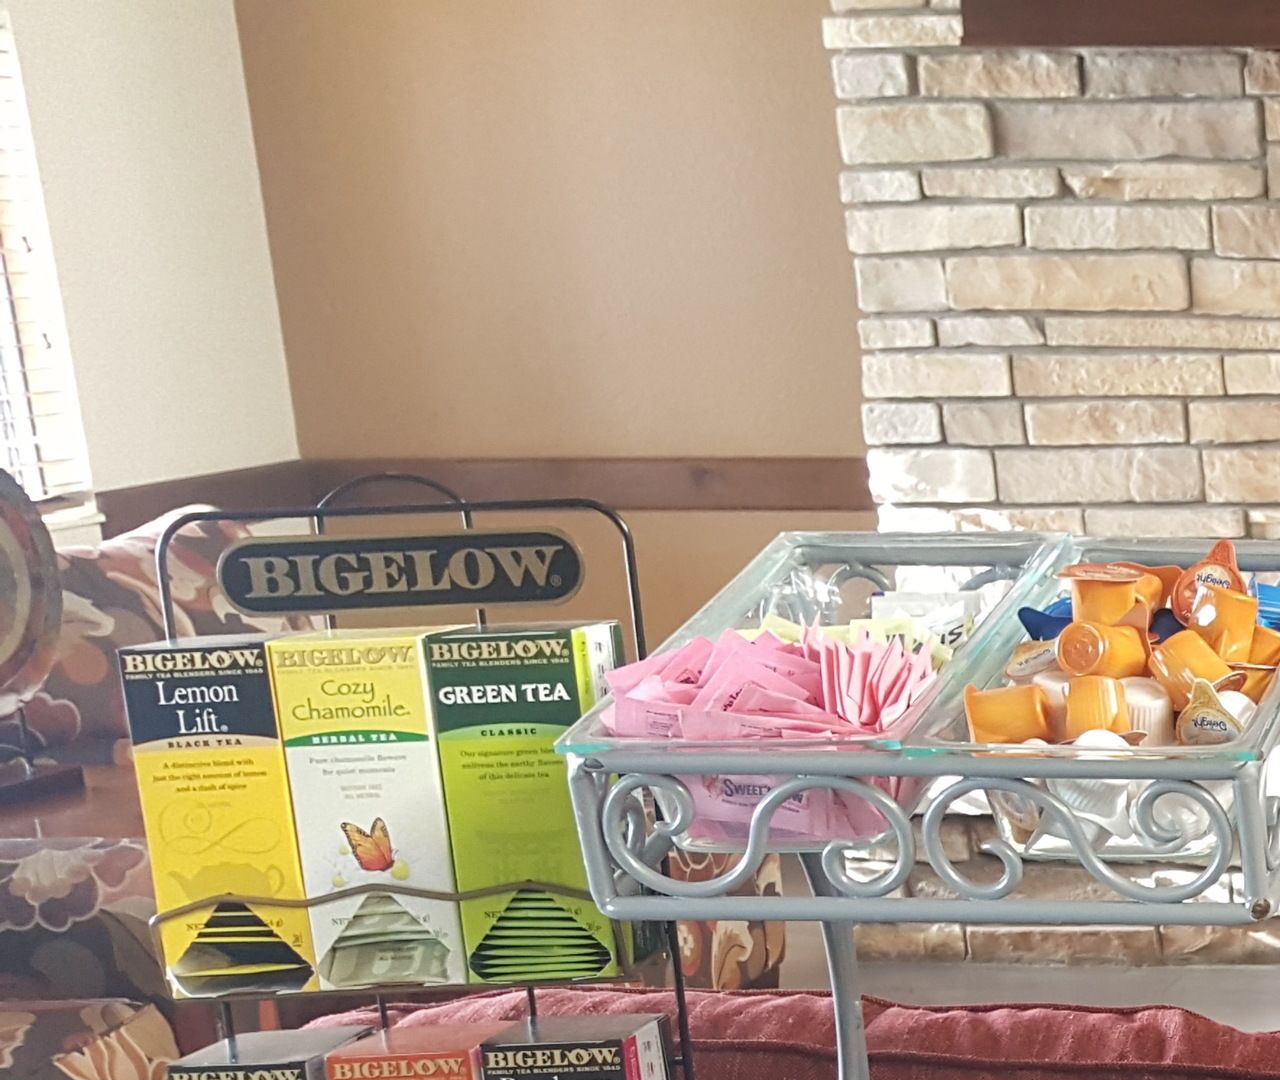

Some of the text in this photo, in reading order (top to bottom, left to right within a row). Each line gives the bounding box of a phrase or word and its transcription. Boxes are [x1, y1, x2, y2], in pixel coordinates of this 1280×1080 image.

[241, 544, 563, 600] BIGELOW
[1196, 573, 1230, 590] Delight
[275, 646, 413, 668] BIGELOW
[430, 639, 567, 660] BIGELOW
[123, 650, 261, 672] BIGELOW
[156, 681, 239, 705] Lemon
[321, 680, 375, 703] Cozy
[438, 683, 571, 704] GREEN TEA
[292, 694, 410, 721] Chamomile
[176, 708, 220, 734] Lift
[1192, 717, 1227, 731] Delight
[312, 733, 397, 744] HERBAL TEA
[481, 728, 537, 736] CLASSIC
[168, 738, 242, 748] BLACK TEA
[478, 750, 514, 758] signature
[516, 749, 538, 758] green
[163, 761, 169, 769] A
[322, 768, 355, 776] for quiet
[510, 760, 536, 769] earthy
[182, 773, 201, 781] right
[234, 770, 242, 778] of
[489, 772, 503, 780] this
[198, 783, 216, 791] dash
[227, 782, 247, 791] spice
[485, 1048, 618, 1068] BIGELOW
[333, 1058, 464, 1080] BIGELOW
